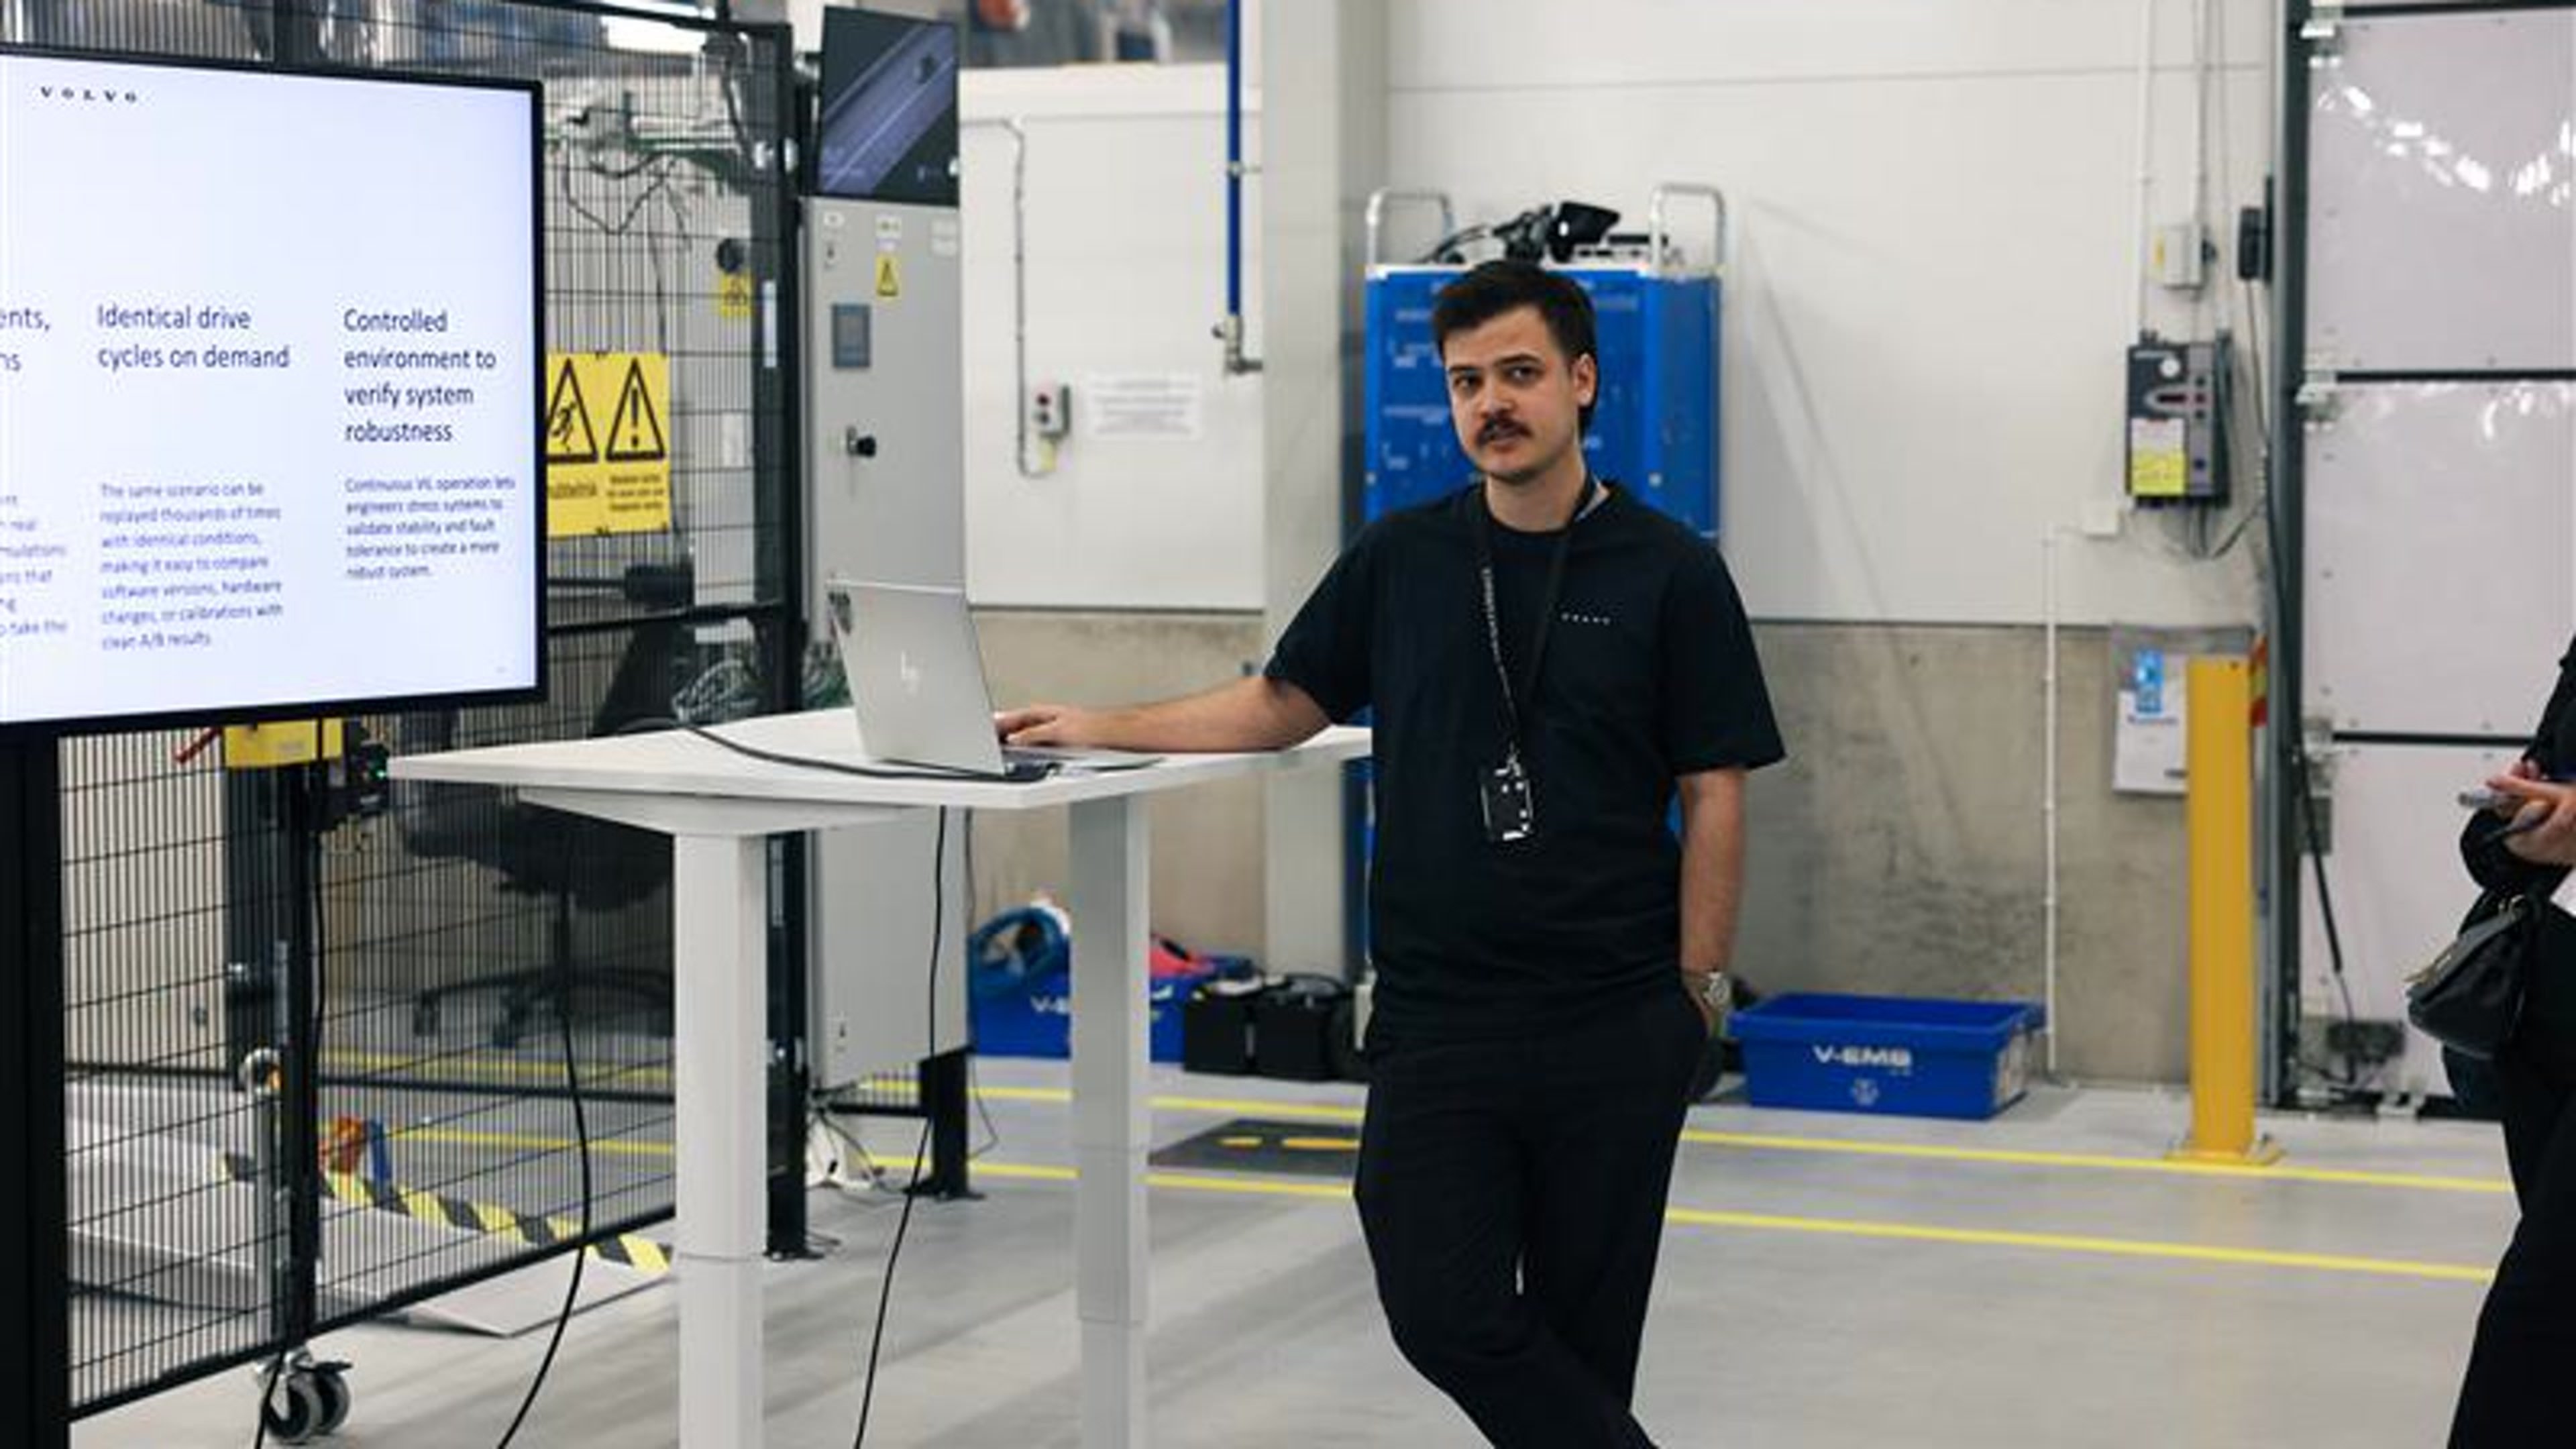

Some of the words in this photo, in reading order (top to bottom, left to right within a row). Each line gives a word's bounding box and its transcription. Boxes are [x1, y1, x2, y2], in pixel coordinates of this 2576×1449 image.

[40, 86, 137, 104] VOLVO
[97, 303, 191, 329] Identical
[198, 305, 252, 329] drive
[344, 308, 448, 333] Controlled
[97, 344, 164, 373] cycles
[170, 348, 197, 368] on
[203, 344, 290, 368] demand
[344, 347, 471, 369] environment
[476, 349, 497, 369] to
[344, 380, 400, 410] verify
[405, 384, 474, 411] system
[345, 419, 453, 443] robustness
[344, 478, 413, 493] Continuous
[436, 477, 491, 492] operation
[101, 507, 158, 525] replayed
[161, 506, 226, 523] thousands
[345, 501, 402, 516] engineers
[346, 521, 393, 535] validate
[396, 519, 441, 535] stability
[444, 517, 468, 533] and
[135, 533, 191, 548] identical
[345, 543, 402, 558] tolerance
[101, 559, 148, 576] making
[212, 556, 268, 573] compare
